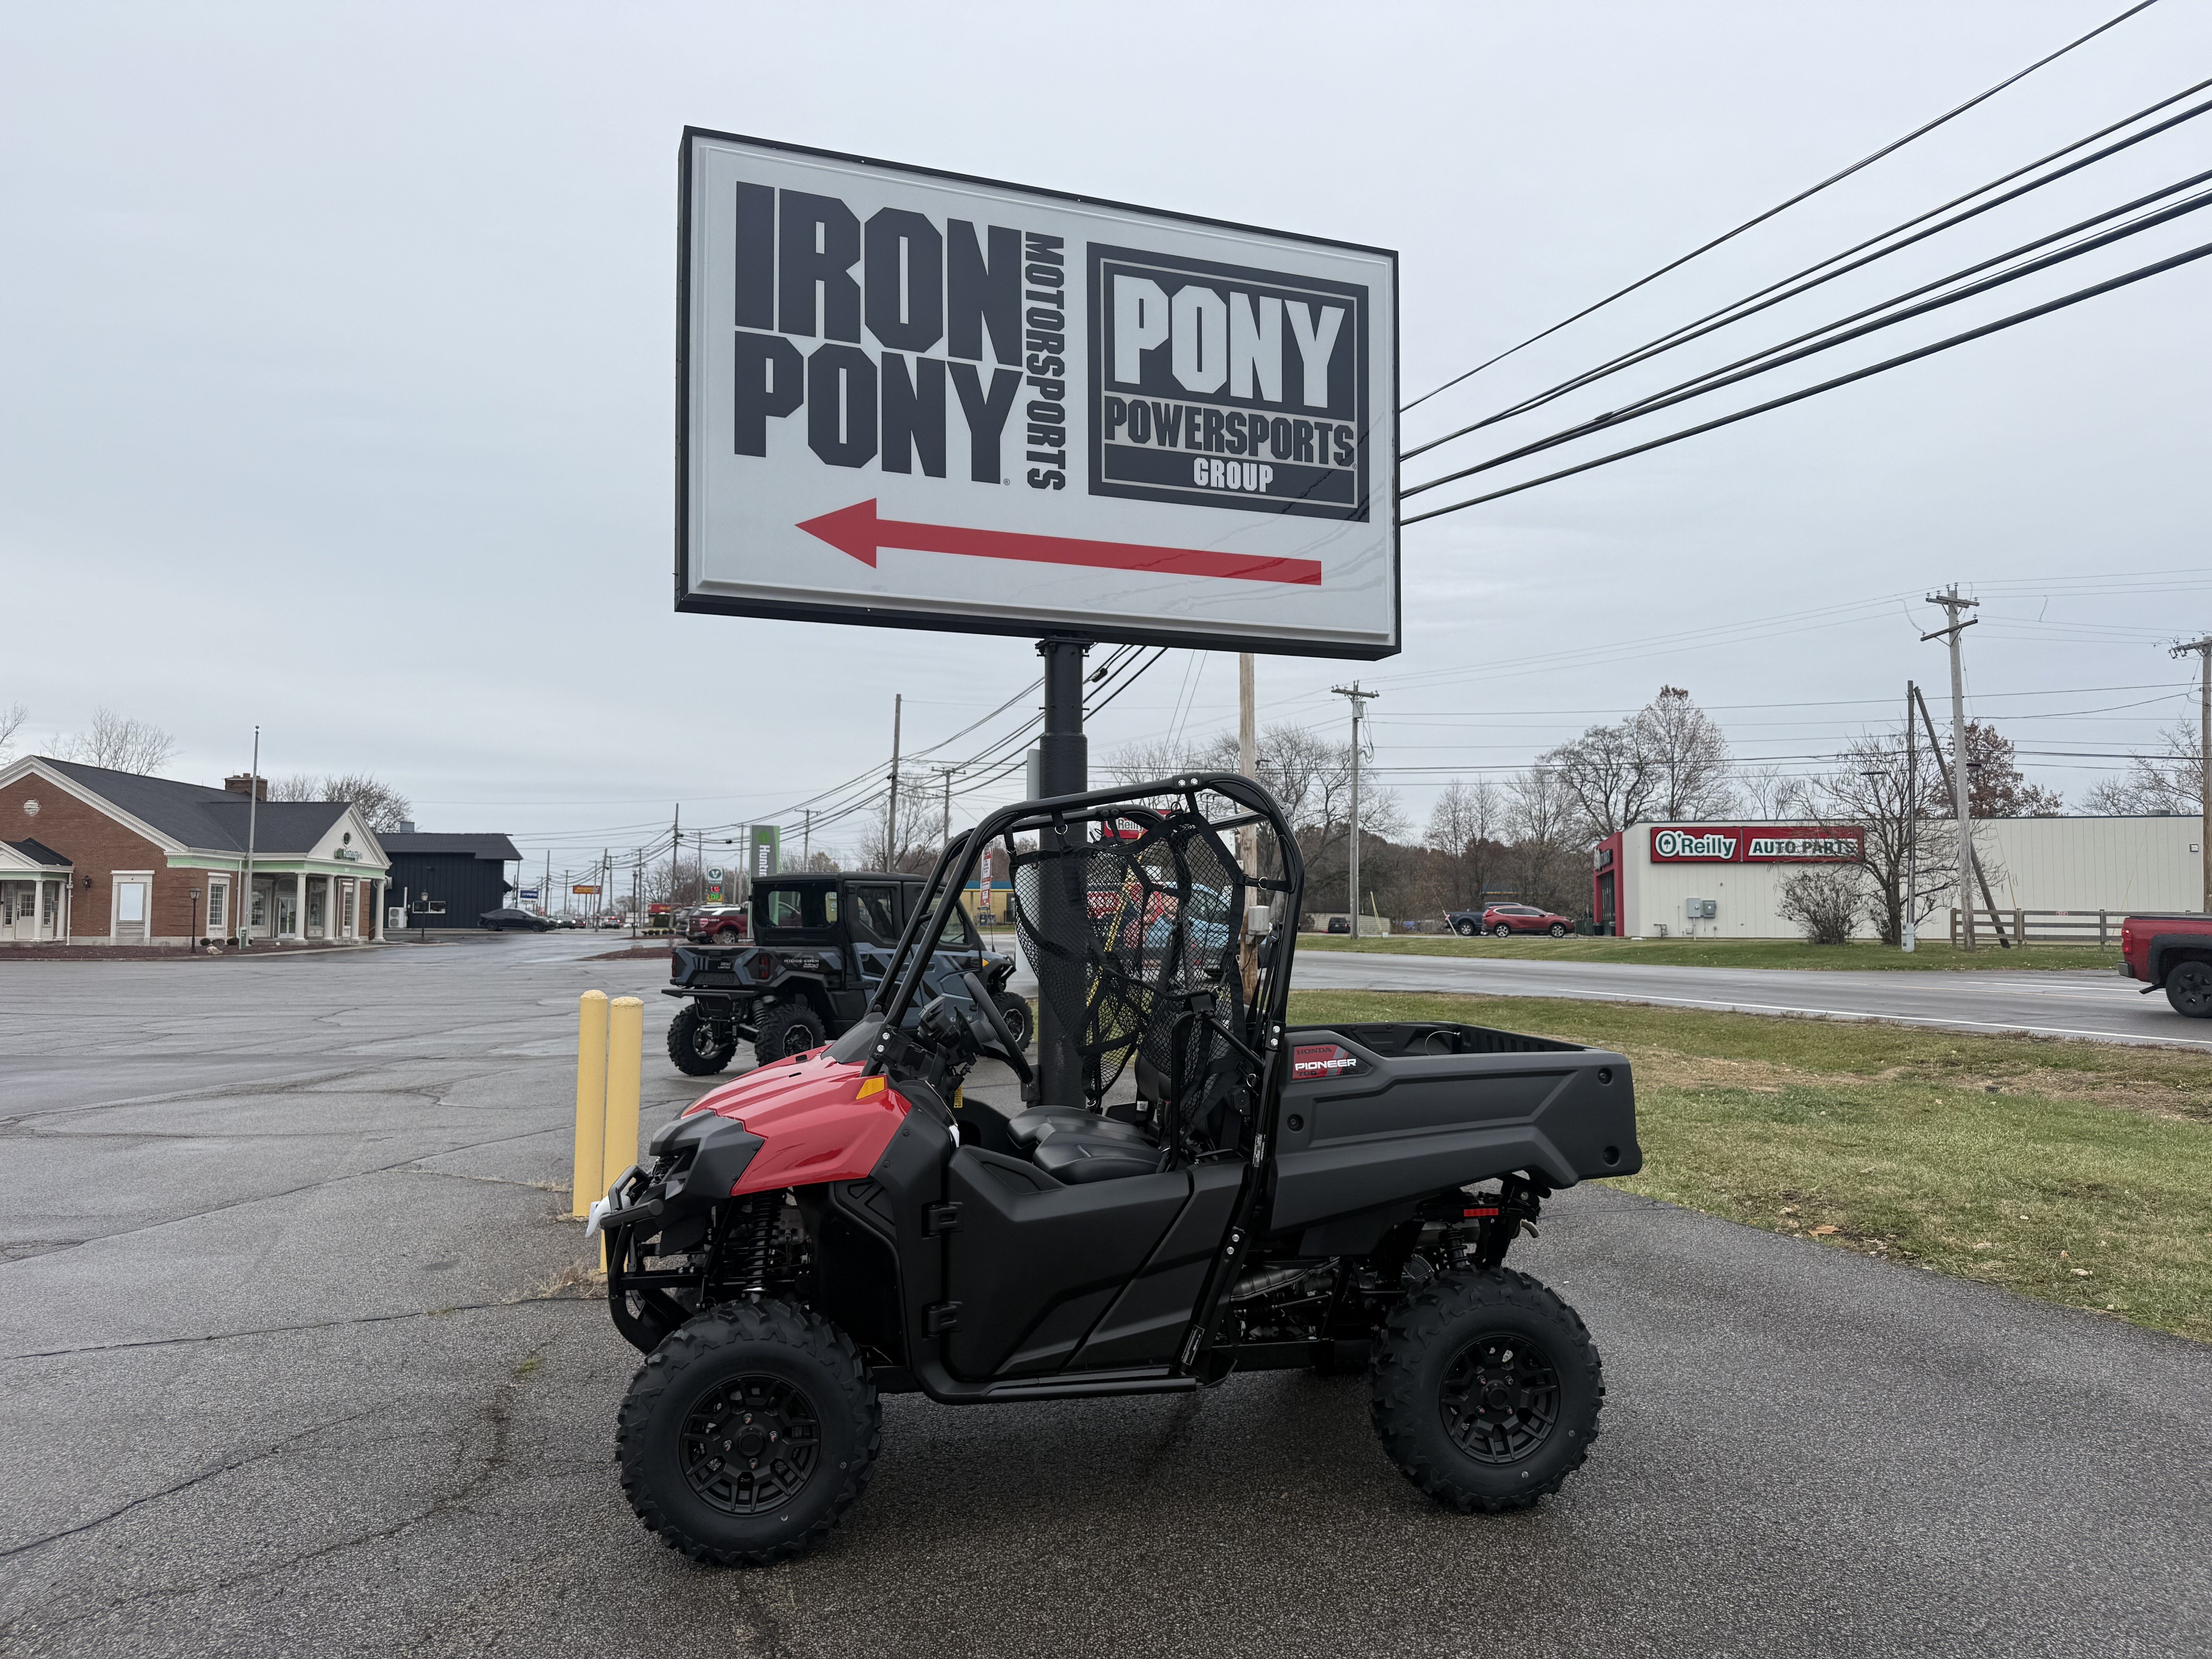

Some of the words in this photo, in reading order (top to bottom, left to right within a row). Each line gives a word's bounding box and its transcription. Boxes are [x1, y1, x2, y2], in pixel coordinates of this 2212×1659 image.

[735, 180, 1023, 367] IRON
[1025, 231, 1066, 491] MOTORSPORTS
[1113, 273, 1345, 409] PONY
[734, 330, 1024, 484] PONY
[1104, 396, 1355, 468] POWERSPORTS
[1193, 458, 1274, 493] GROUP
[1658, 833, 1733, 856] O'Reilly
[1752, 841, 1796, 854] AUTO
[1802, 841, 1858, 854] PARTS
[1295, 1058, 1357, 1071] PIONEER
